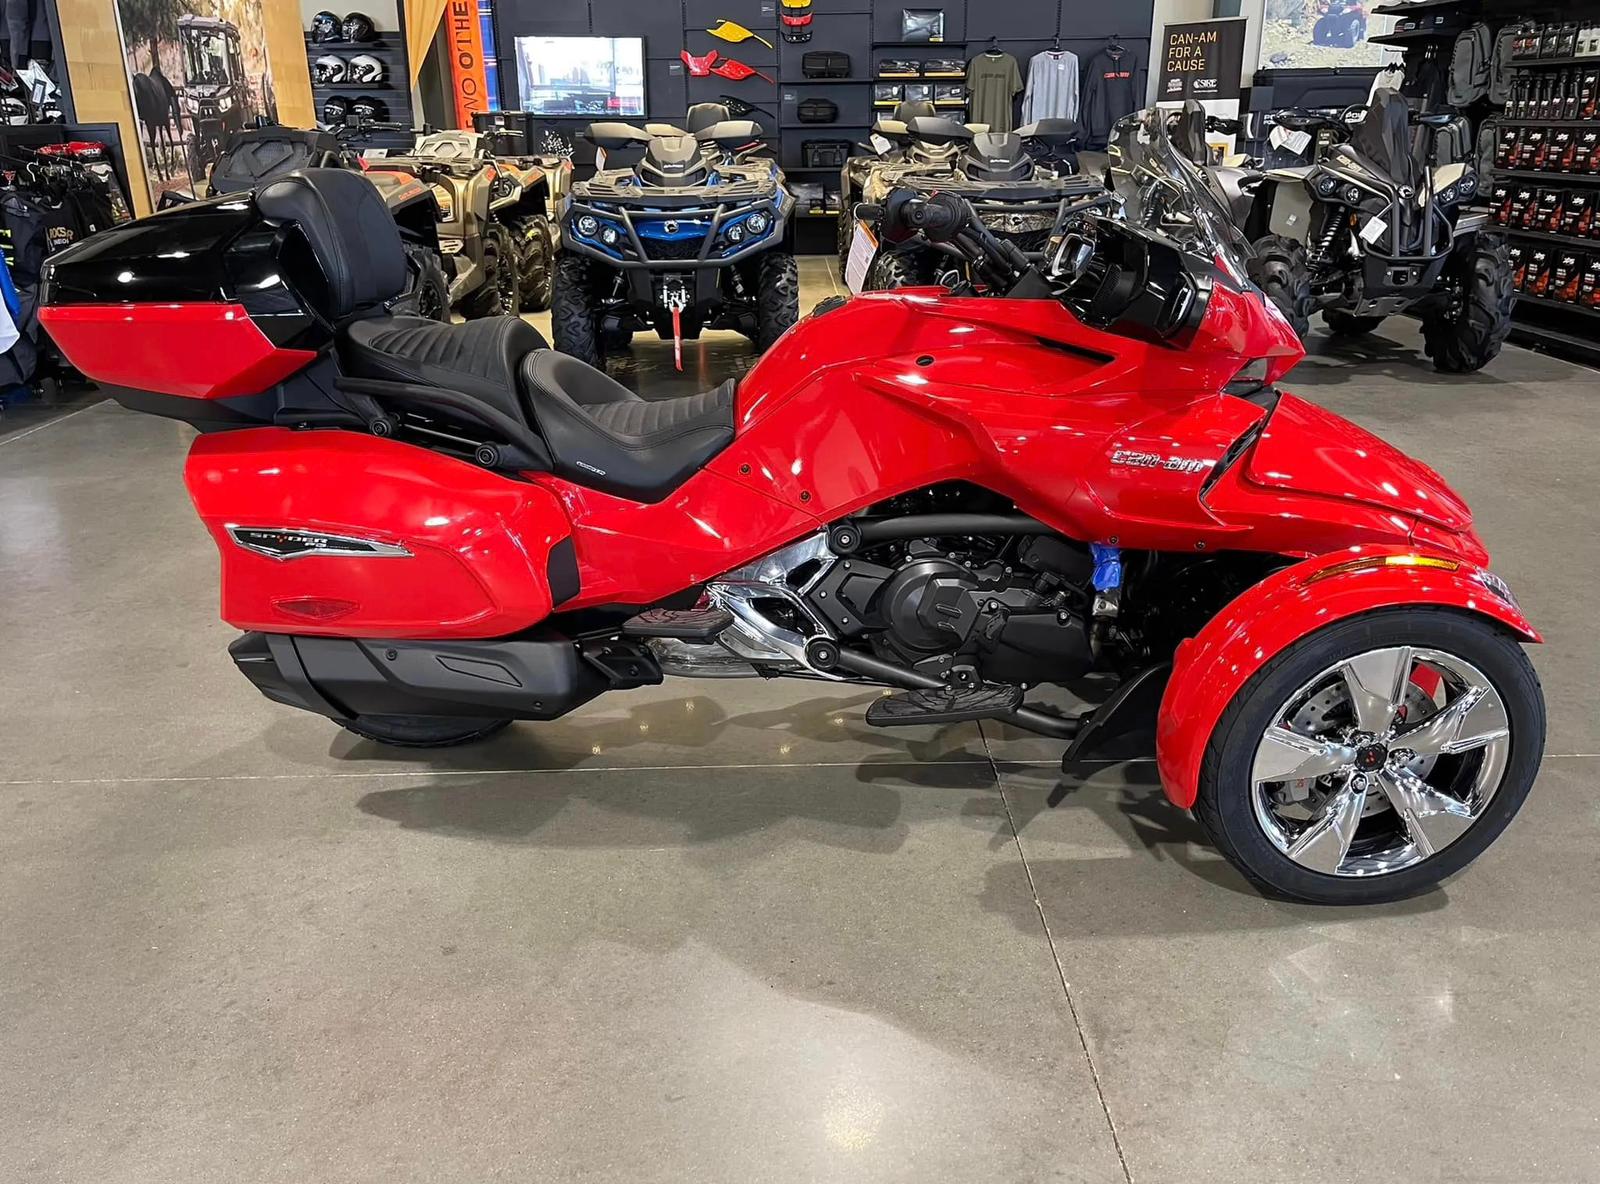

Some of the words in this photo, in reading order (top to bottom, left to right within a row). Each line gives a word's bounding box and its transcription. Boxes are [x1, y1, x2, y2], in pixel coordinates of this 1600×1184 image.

[1170, 31, 1217, 45] CAN-AM
[1168, 47, 1191, 58] FOR
[1194, 46, 1202, 57] A
[1167, 59, 1205, 72] CAUSE
